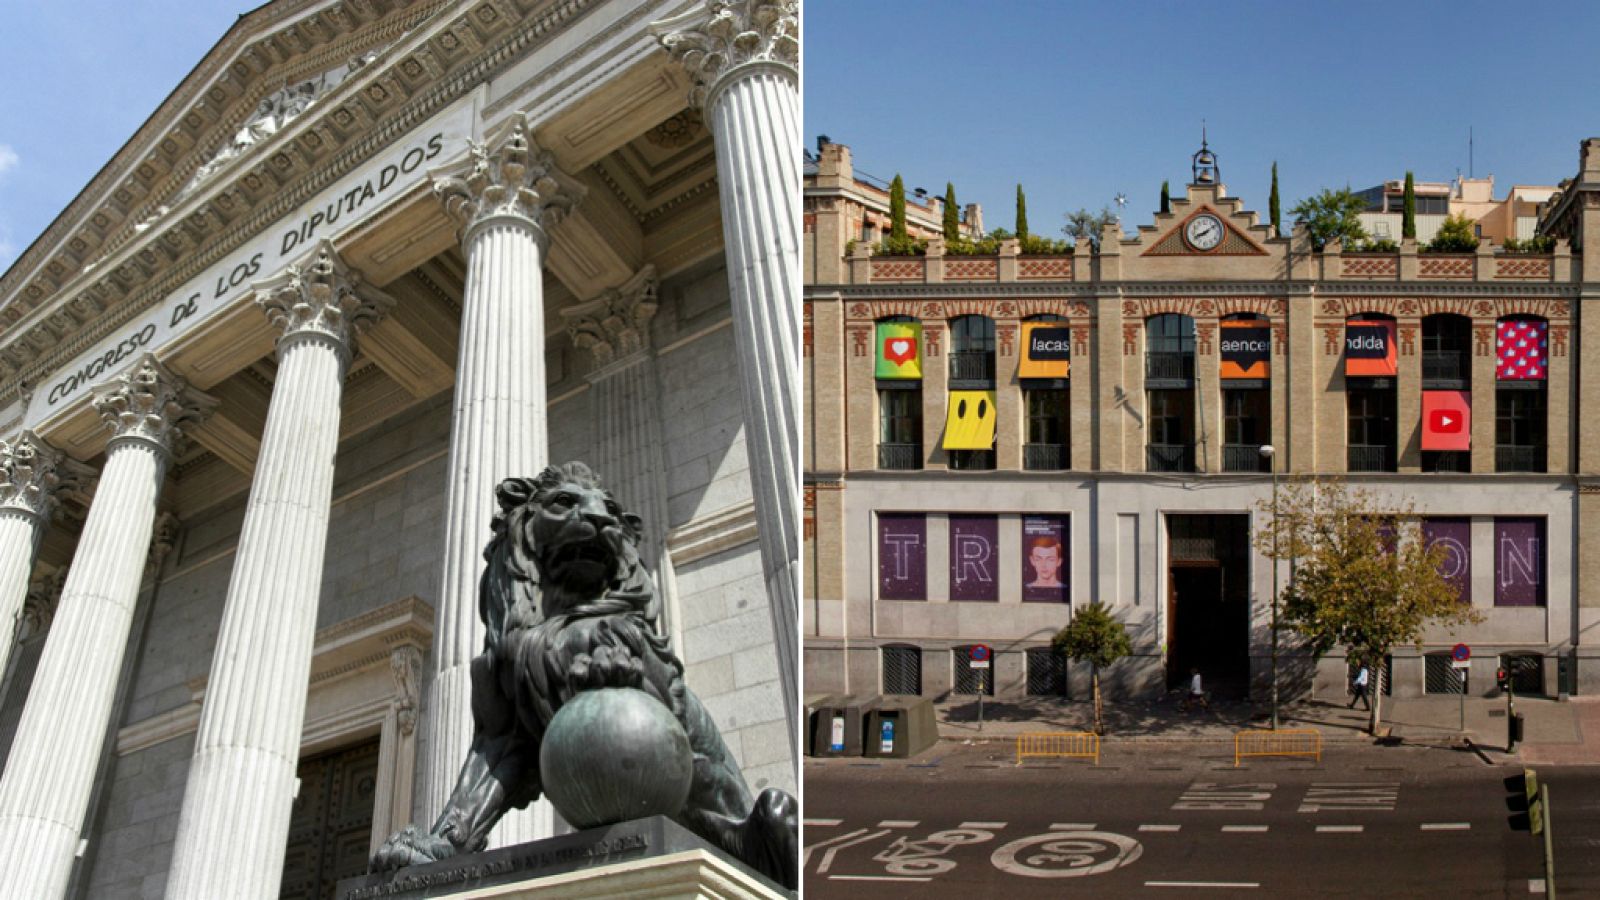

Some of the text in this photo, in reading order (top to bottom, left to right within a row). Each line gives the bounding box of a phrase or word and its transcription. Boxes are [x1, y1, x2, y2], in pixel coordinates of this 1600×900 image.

[48, 132, 443, 405] CONGRESO DE LOS DIPUTADOS
[1170, 782, 1277, 810] BUS
[1027, 841, 1107, 867] 30
